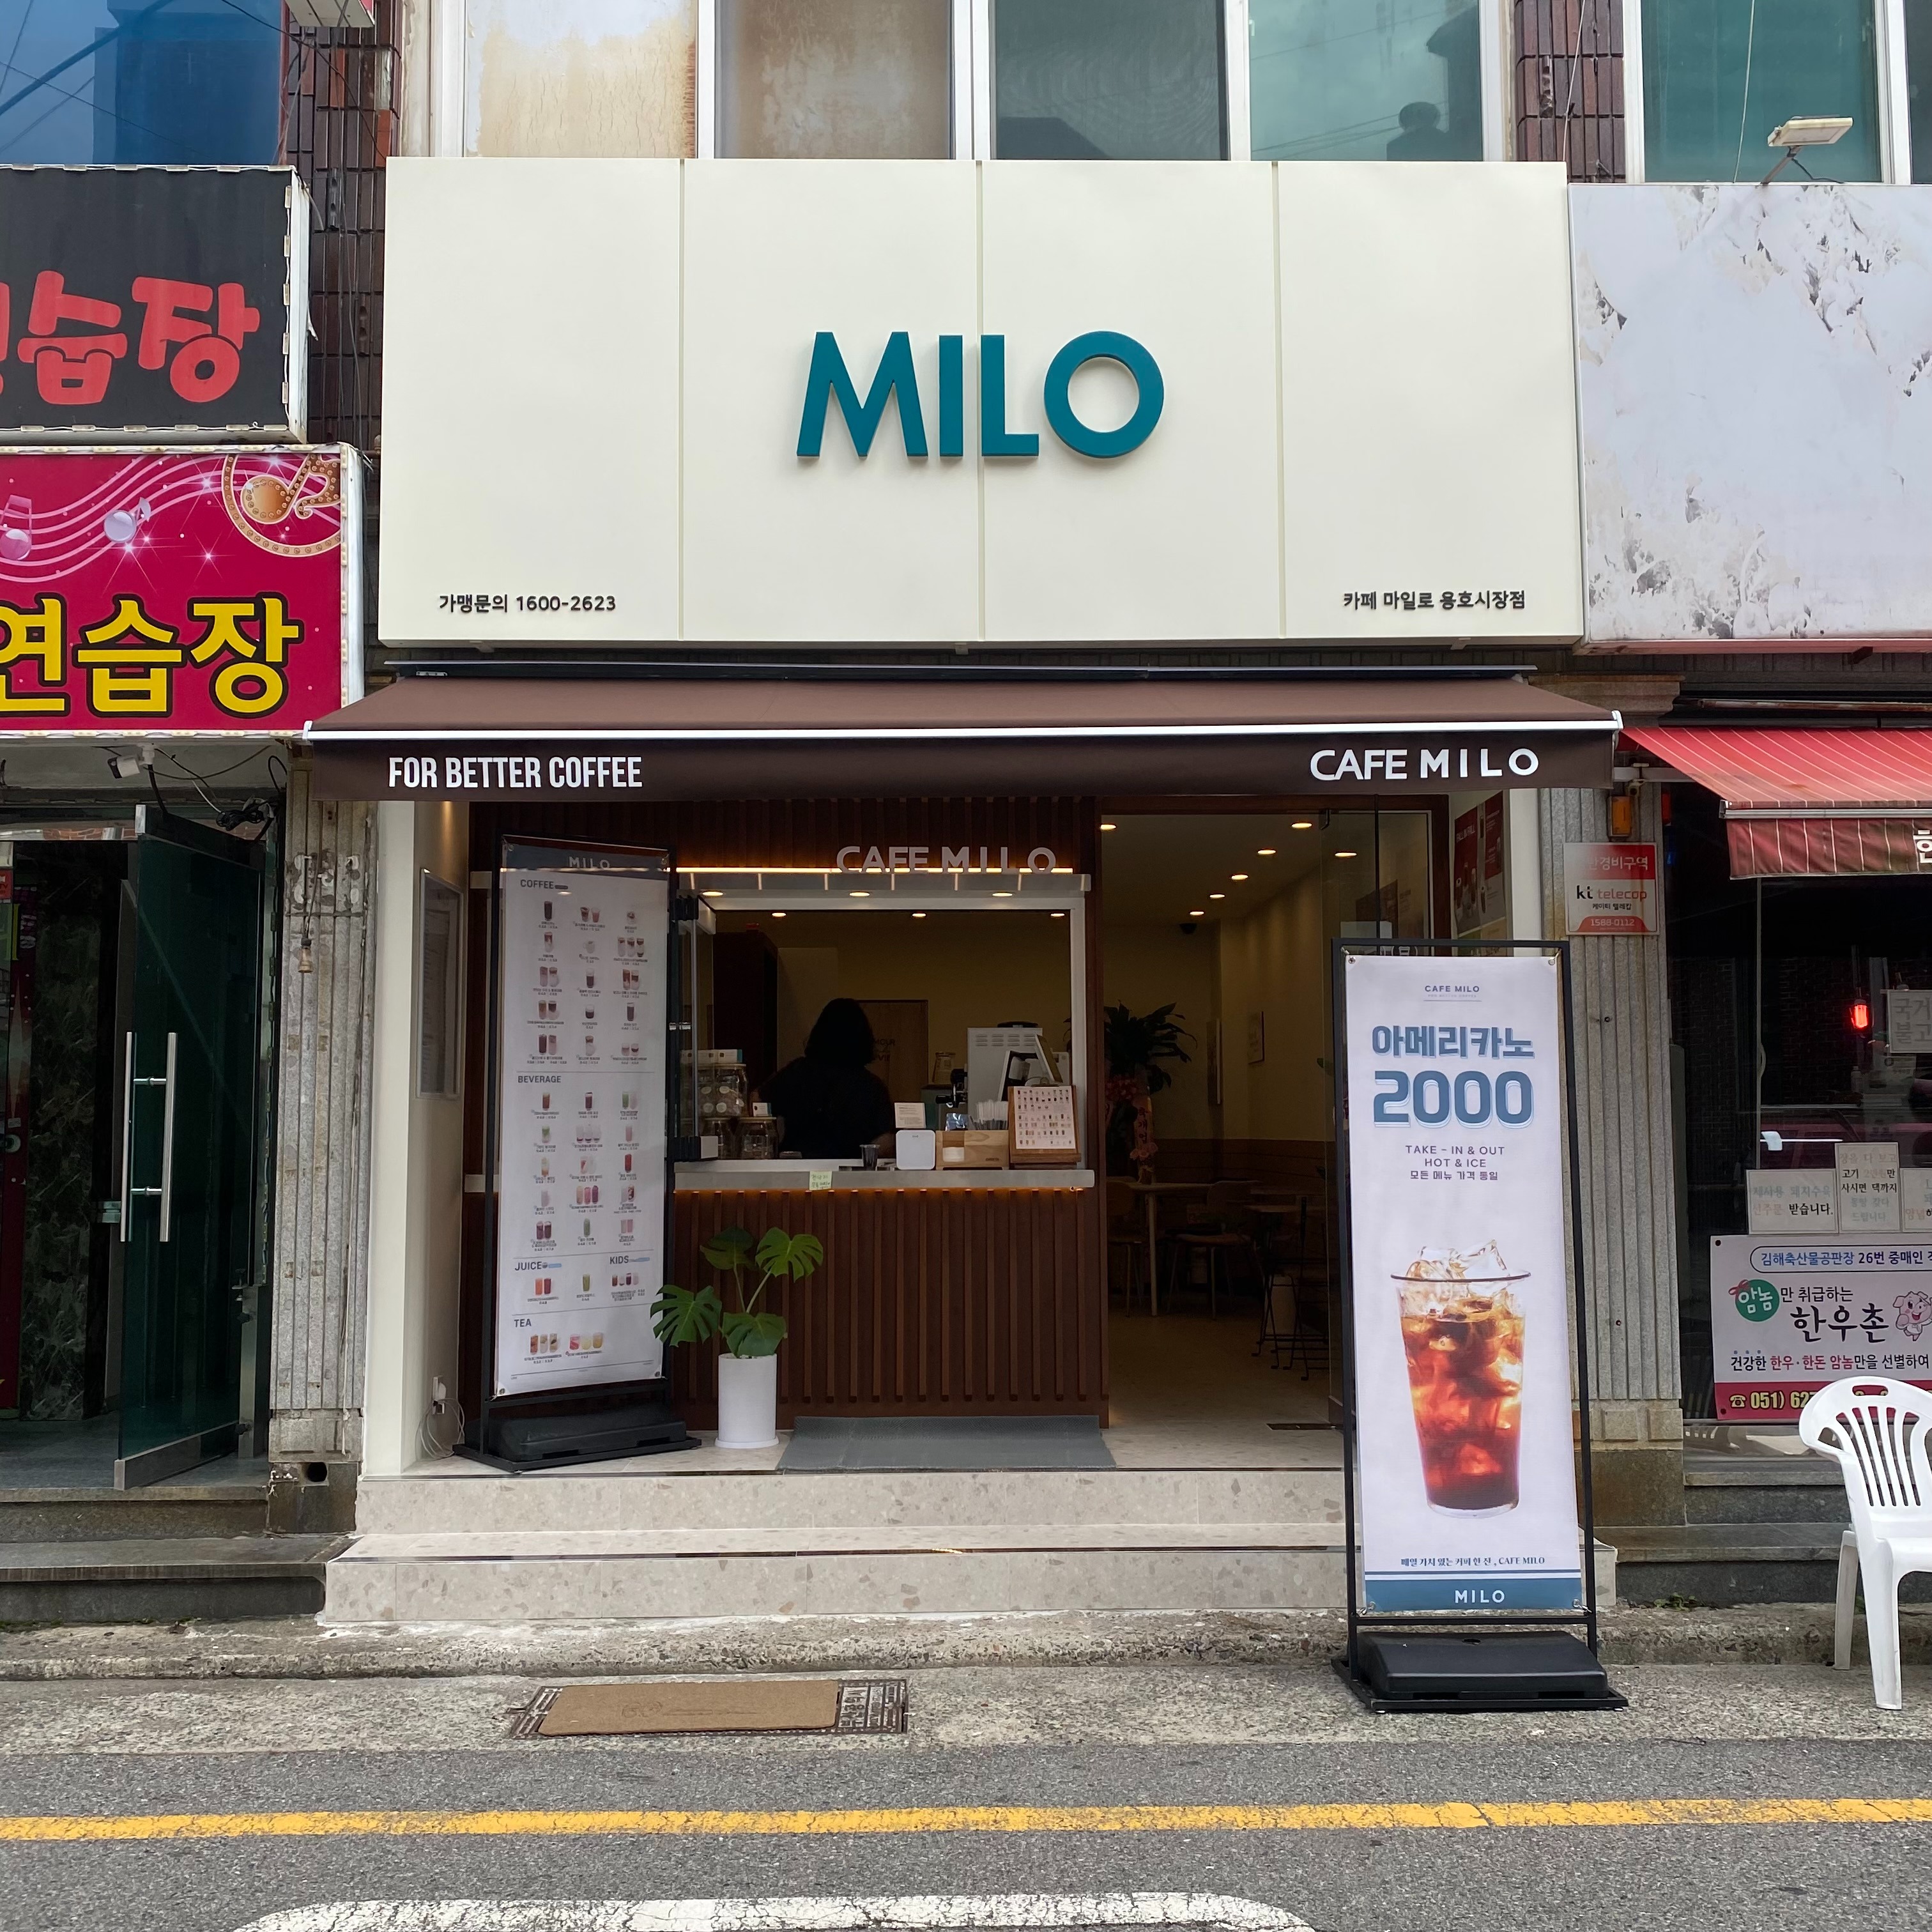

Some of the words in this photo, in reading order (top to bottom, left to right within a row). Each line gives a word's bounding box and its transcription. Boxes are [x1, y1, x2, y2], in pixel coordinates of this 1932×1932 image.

[0, 270, 260, 405] 습장
[796, 330, 1165, 459] MILO
[439, 594, 507, 612] 가맹문의
[516, 595, 616, 611] 1600-2623
[1344, 592, 1376, 610] 카페
[1383, 591, 1434, 610] 마일로
[1440, 590, 1525, 610] 용호시장점
[1310, 749, 1407, 781] CAFE
[1420, 748, 1539, 778] MILO
[388, 756, 438, 788] FOR
[445, 756, 541, 788] BETTER
[549, 756, 643, 788] COFFEE
[569, 856, 610, 869] MILO
[836, 845, 929, 874] CAFE
[941, 846, 1056, 874] MILO
[520, 879, 555, 889] COFFEE
[1598, 888, 1647, 902] telecop
[1372, 1025, 1535, 1059] 아메리카노
[518, 1075, 562, 1084] BEVERAGE
[1373, 1070, 1534, 1129] 2000
[1406, 1146, 1437, 1154] TAKE
[1452, 1146, 1463, 1154] IN
[1468, 1146, 1475, 1154] &
[1480, 1146, 1505, 1154] OUT
[1425, 1158, 1450, 1167] HOT
[1455, 1159, 1462, 1167] &
[1467, 1159, 1486, 1167] ICE
[1411, 1170, 1429, 1179] 모든
[1433, 1170, 1452, 1180] 메뉴
[1457, 1171, 1475, 1180] 가격
[1841, 1169, 1859, 1179] 고기
[1840, 1183, 1867, 1193] 사시면
[1871, 1183, 1897, 1193] 댁까지
[1789, 1203, 1834, 1216] 받습니다.
[610, 1255, 629, 1264] KIDS
[1761, 1252, 1854, 1266] 김해축산물공판장
[1858, 1252, 1885, 1265] 26번
[1888, 1251, 1923, 1265] 중매인
[514, 1261, 542, 1271] JUICE
[1738, 1287, 1774, 1314] 암놈
[1781, 1287, 1793, 1303] 만
[1798, 1287, 1853, 1303] 취급하는
[514, 1319, 532, 1327] TEA
[1790, 1303, 1889, 1343] 한우촌
[1731, 1356, 1767, 1371] 건강한
[1830, 1355, 1878, 1370] 암놈만을
[1882, 1354, 1930, 1369] 선별하여
[1750, 1390, 1785, 1409] 051)
[1498, 1557, 1521, 1565] CAFE
[1522, 1556, 1545, 1565] MILO
[1454, 1590, 1505, 1604] MILO
